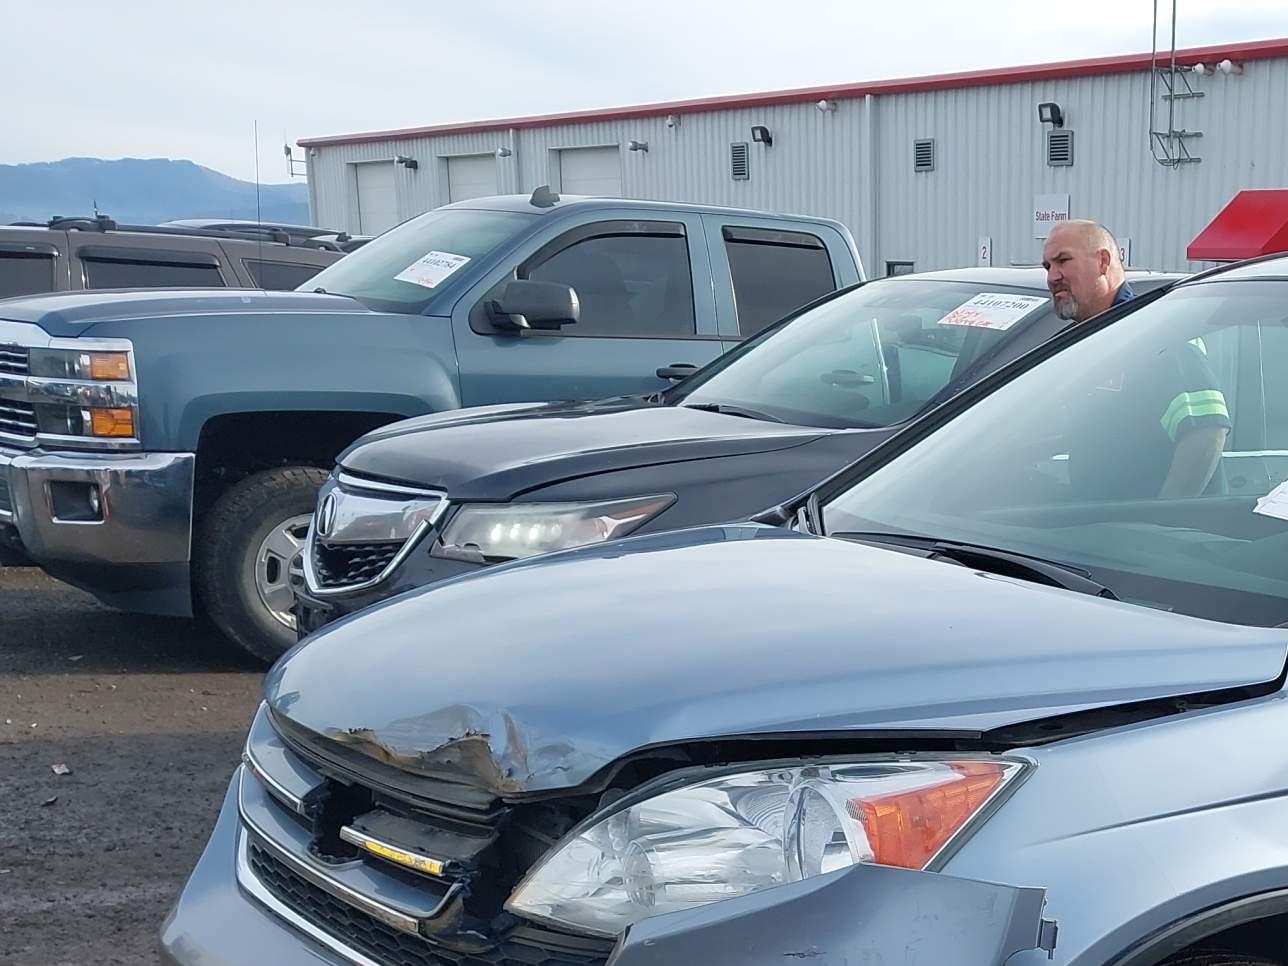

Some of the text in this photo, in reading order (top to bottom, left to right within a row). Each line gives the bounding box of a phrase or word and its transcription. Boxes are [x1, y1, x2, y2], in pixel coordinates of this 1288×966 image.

[1035, 211, 1067, 221] State Farm
[982, 246, 988, 260] 2
